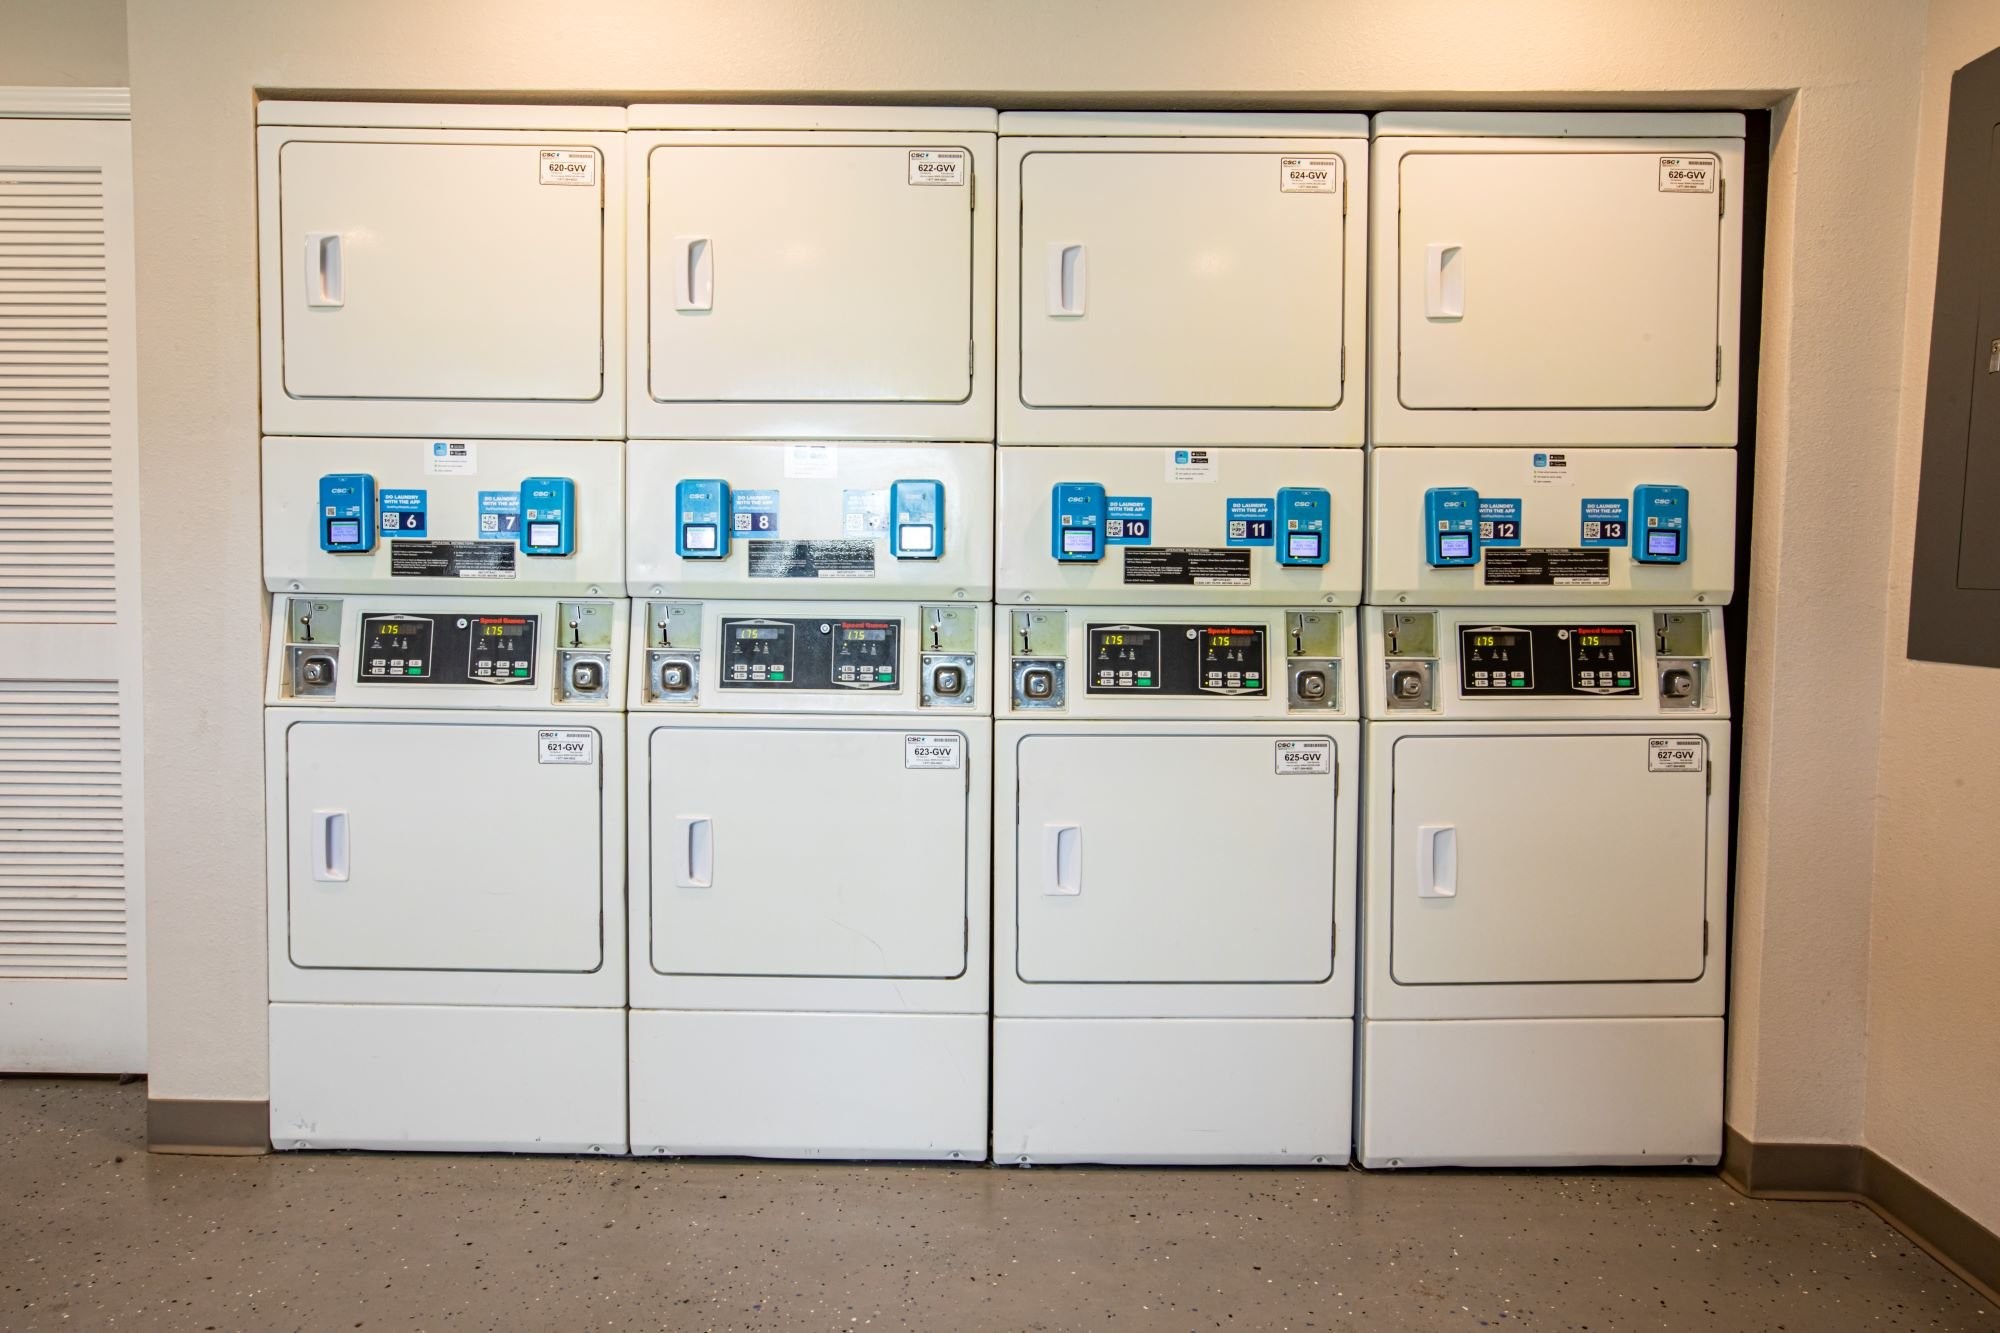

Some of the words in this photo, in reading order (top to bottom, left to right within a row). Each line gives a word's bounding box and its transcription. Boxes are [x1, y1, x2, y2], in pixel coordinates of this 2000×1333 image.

[549, 164, 586, 172] 620-GVV
[918, 164, 956, 172] 622-GVV
[1669, 171, 1706, 179] 626-GVV
[406, 514, 417, 528] 6
[505, 516, 516, 530] 7
[759, 515, 769, 529] 8
[1126, 522, 1144, 536] 10
[1252, 523, 1265, 537] 11
[1498, 524, 1514, 537] 12
[1604, 524, 1621, 537] 13
[547, 743, 584, 751] 621-GVV
[914, 748, 951, 756] 623-GVV
[1658, 751, 1694, 759] 627-GVV
